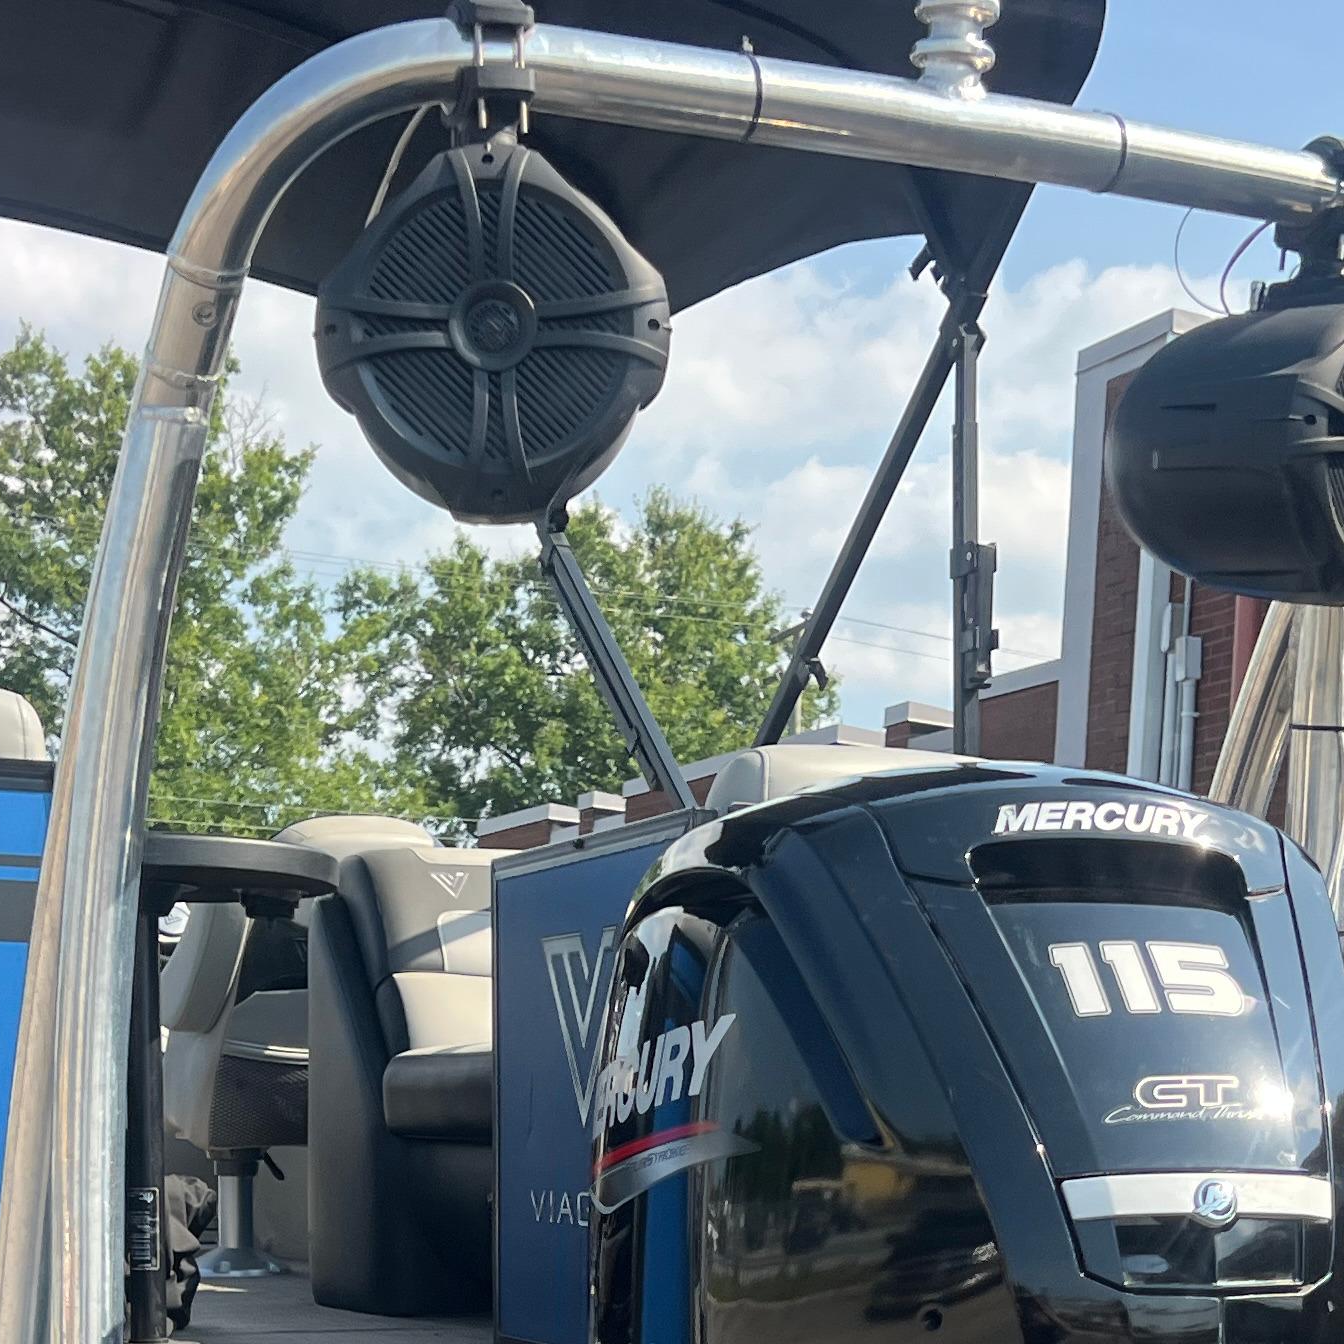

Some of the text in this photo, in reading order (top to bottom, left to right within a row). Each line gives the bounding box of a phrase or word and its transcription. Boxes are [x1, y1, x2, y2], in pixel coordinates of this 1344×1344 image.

[991, 801, 1209, 837] MERCURY
[1048, 940, 1245, 1017] 115
[1133, 1075, 1239, 1108] GT
